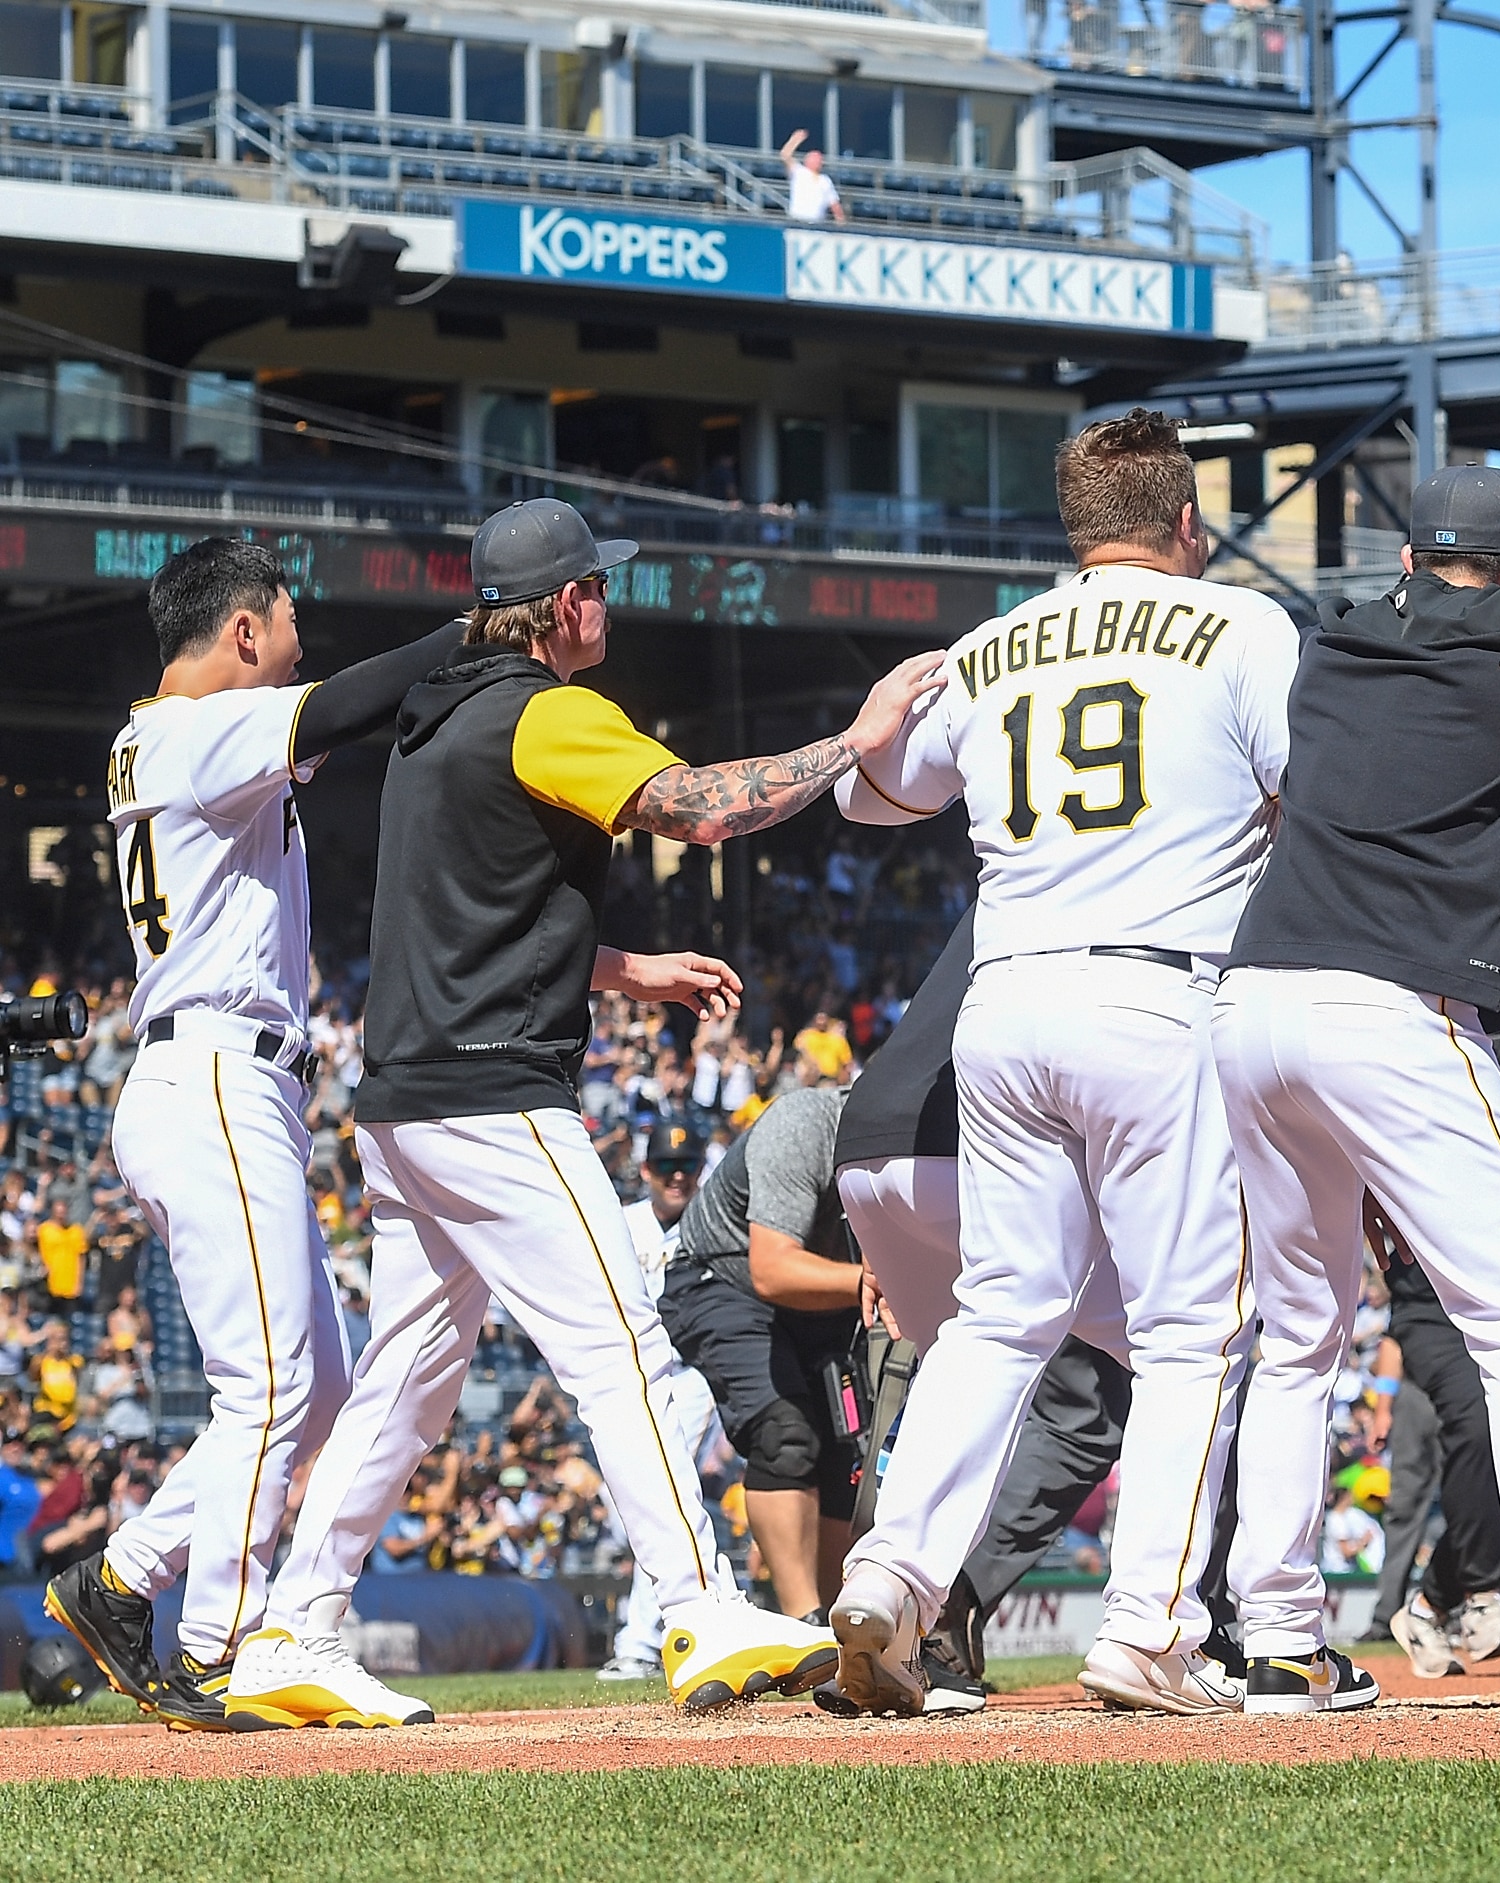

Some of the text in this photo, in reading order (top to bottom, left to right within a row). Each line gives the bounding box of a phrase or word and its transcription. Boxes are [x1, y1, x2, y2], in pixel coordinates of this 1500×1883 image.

[519, 206, 729, 283] KOPPERS
[957, 600, 1230, 703] VOGELBACH
[1001, 677, 1153, 844] 19
